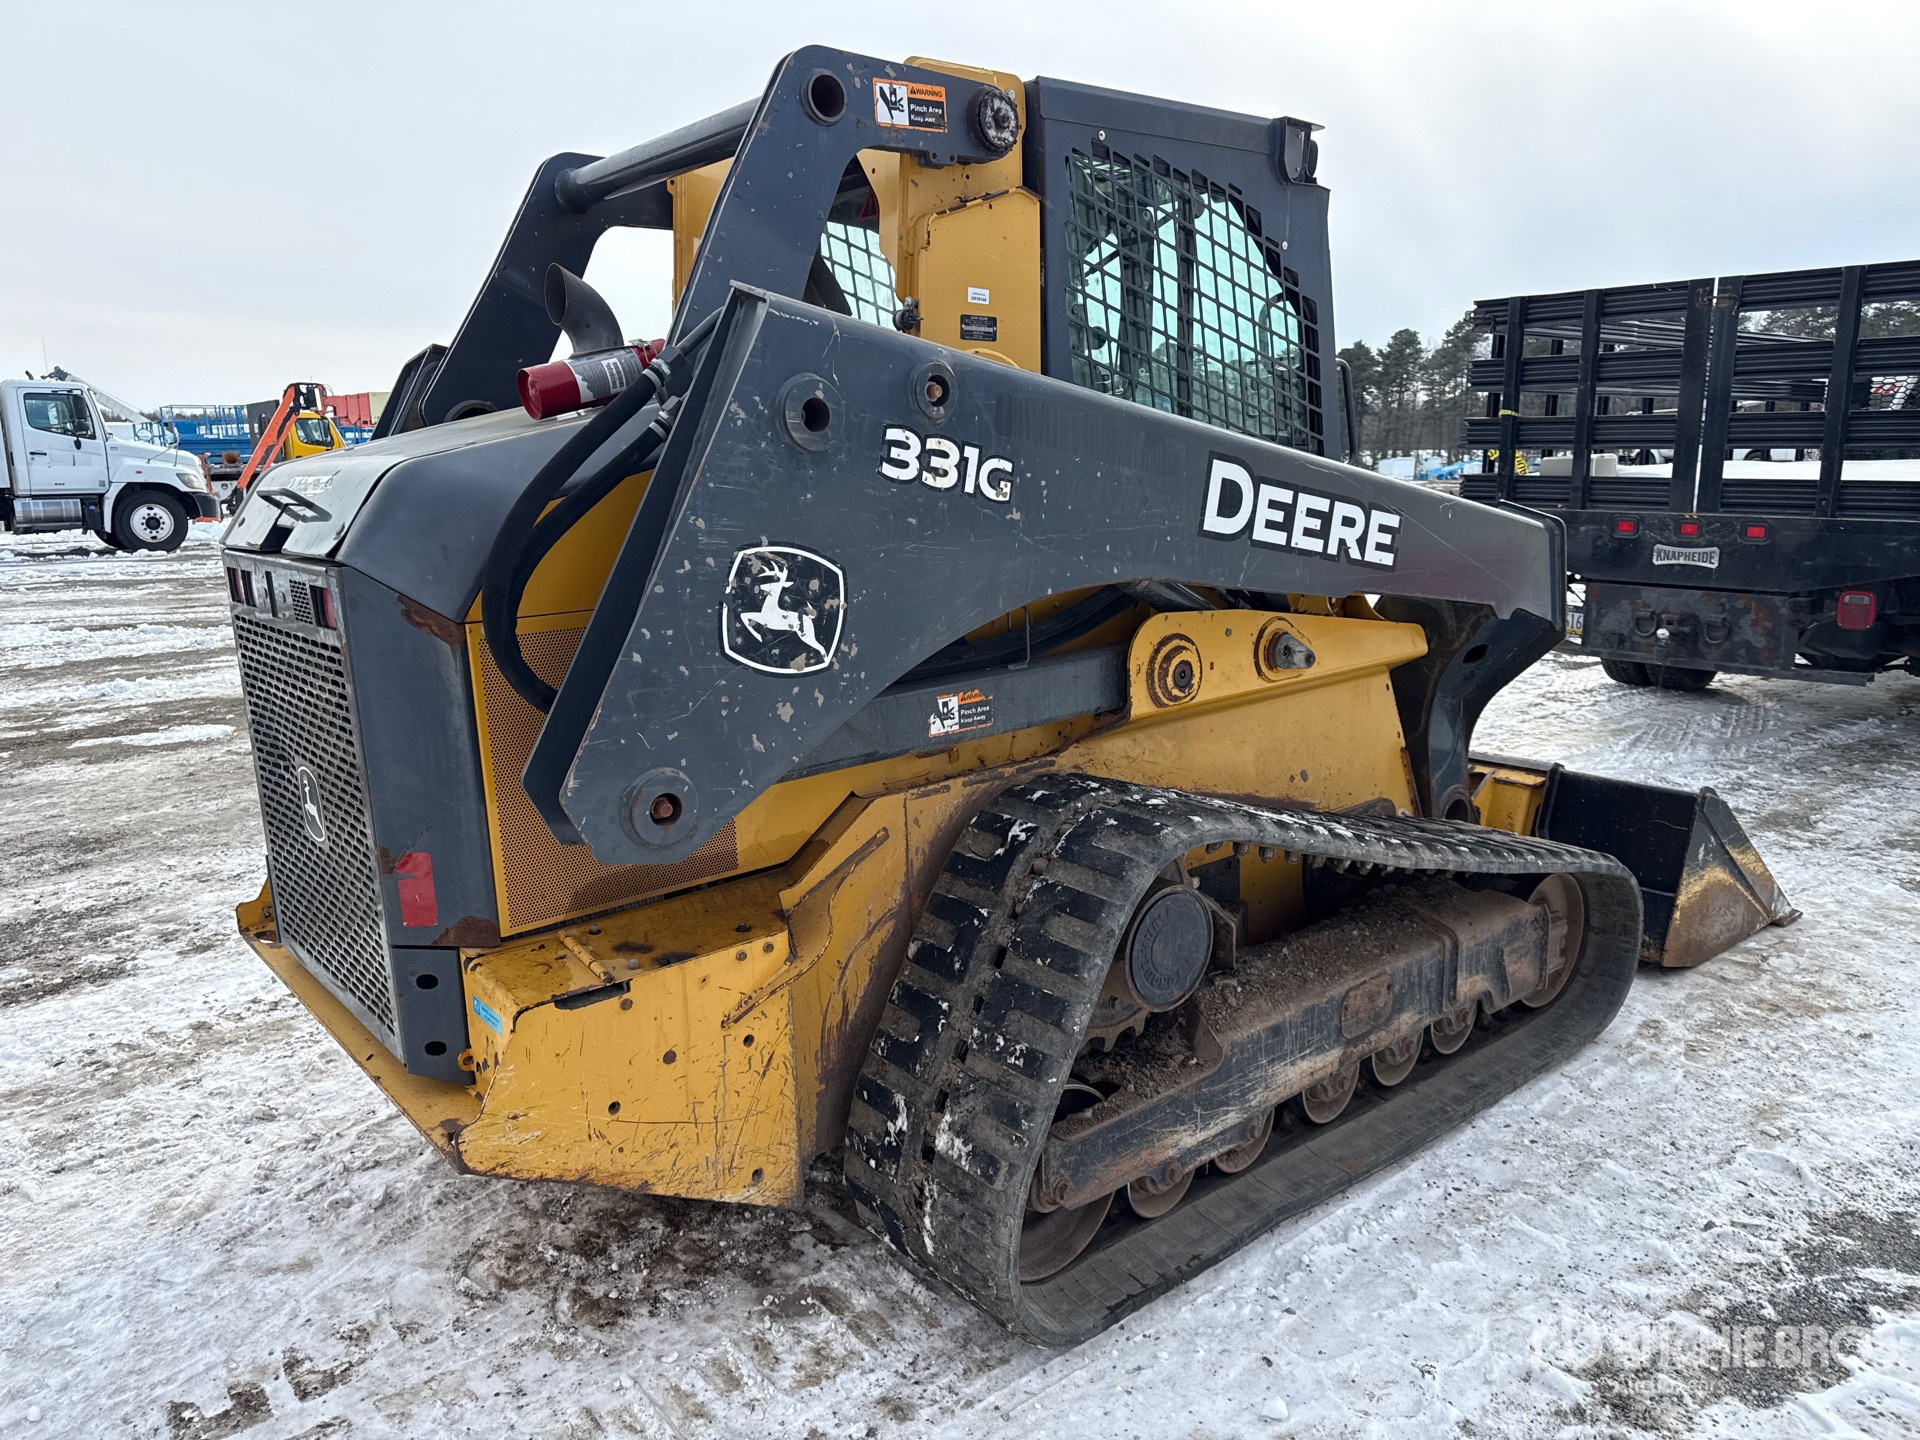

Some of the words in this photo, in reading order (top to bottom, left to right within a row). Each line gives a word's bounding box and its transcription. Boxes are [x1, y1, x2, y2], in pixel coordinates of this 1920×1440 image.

[916, 88, 943, 98] WARNING
[910, 103, 928, 113] Pinch
[928, 106, 942, 114] Area
[880, 427, 1014, 503] 331G
[1203, 458, 1401, 567] DEERE
[1655, 547, 1716, 566] KNAPHEIDE
[960, 707, 977, 716] Pinch
